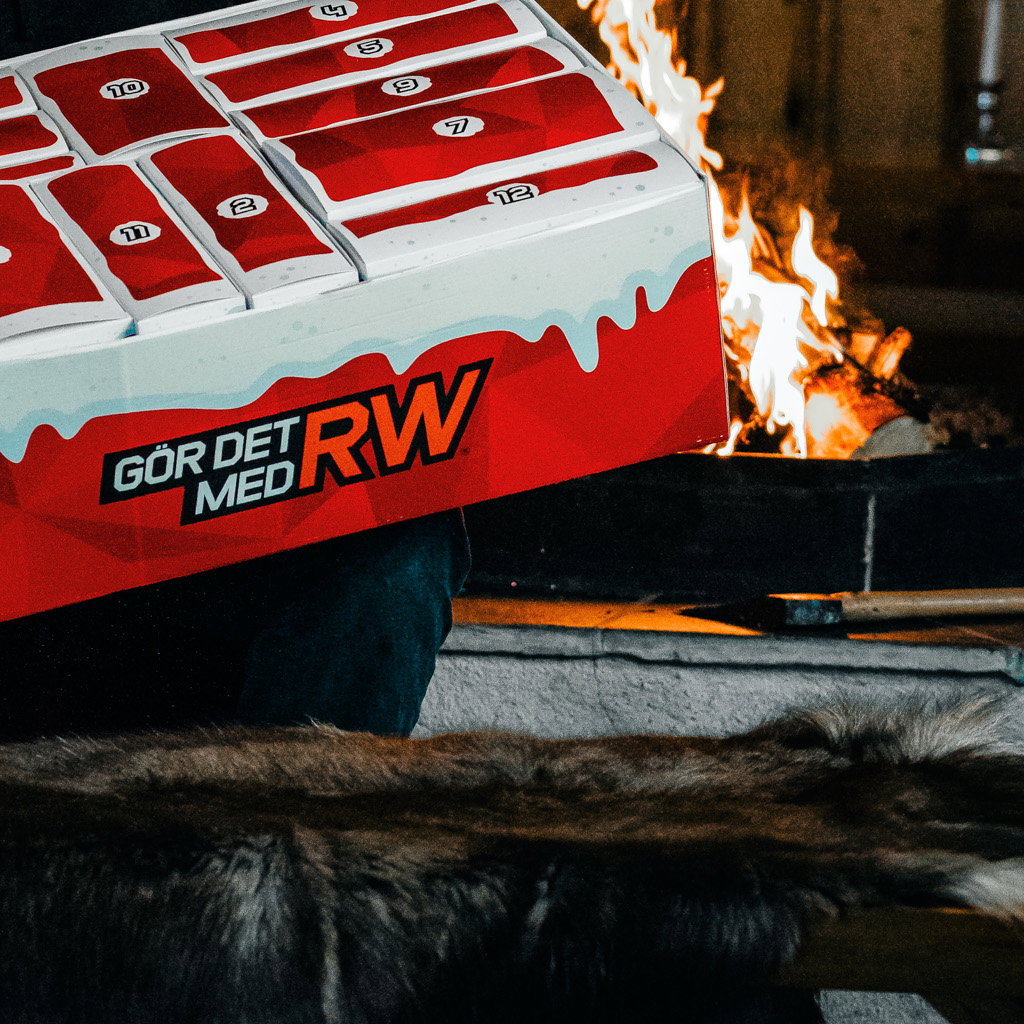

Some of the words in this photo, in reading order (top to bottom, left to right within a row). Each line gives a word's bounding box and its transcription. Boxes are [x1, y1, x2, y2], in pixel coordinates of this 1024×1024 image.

[321, 5, 347, 18] 4
[357, 39, 383, 55] 5
[107, 80, 145, 98] 10
[394, 78, 419, 94] 9
[445, 118, 469, 135] 7
[493, 185, 535, 205] 12
[230, 197, 256, 215] 2
[120, 224, 150, 242] 11
[299, 369, 481, 489] RW
[114, 442, 205, 492] GÖR
[214, 416, 300, 469] DET
[194, 460, 295, 516] MED
